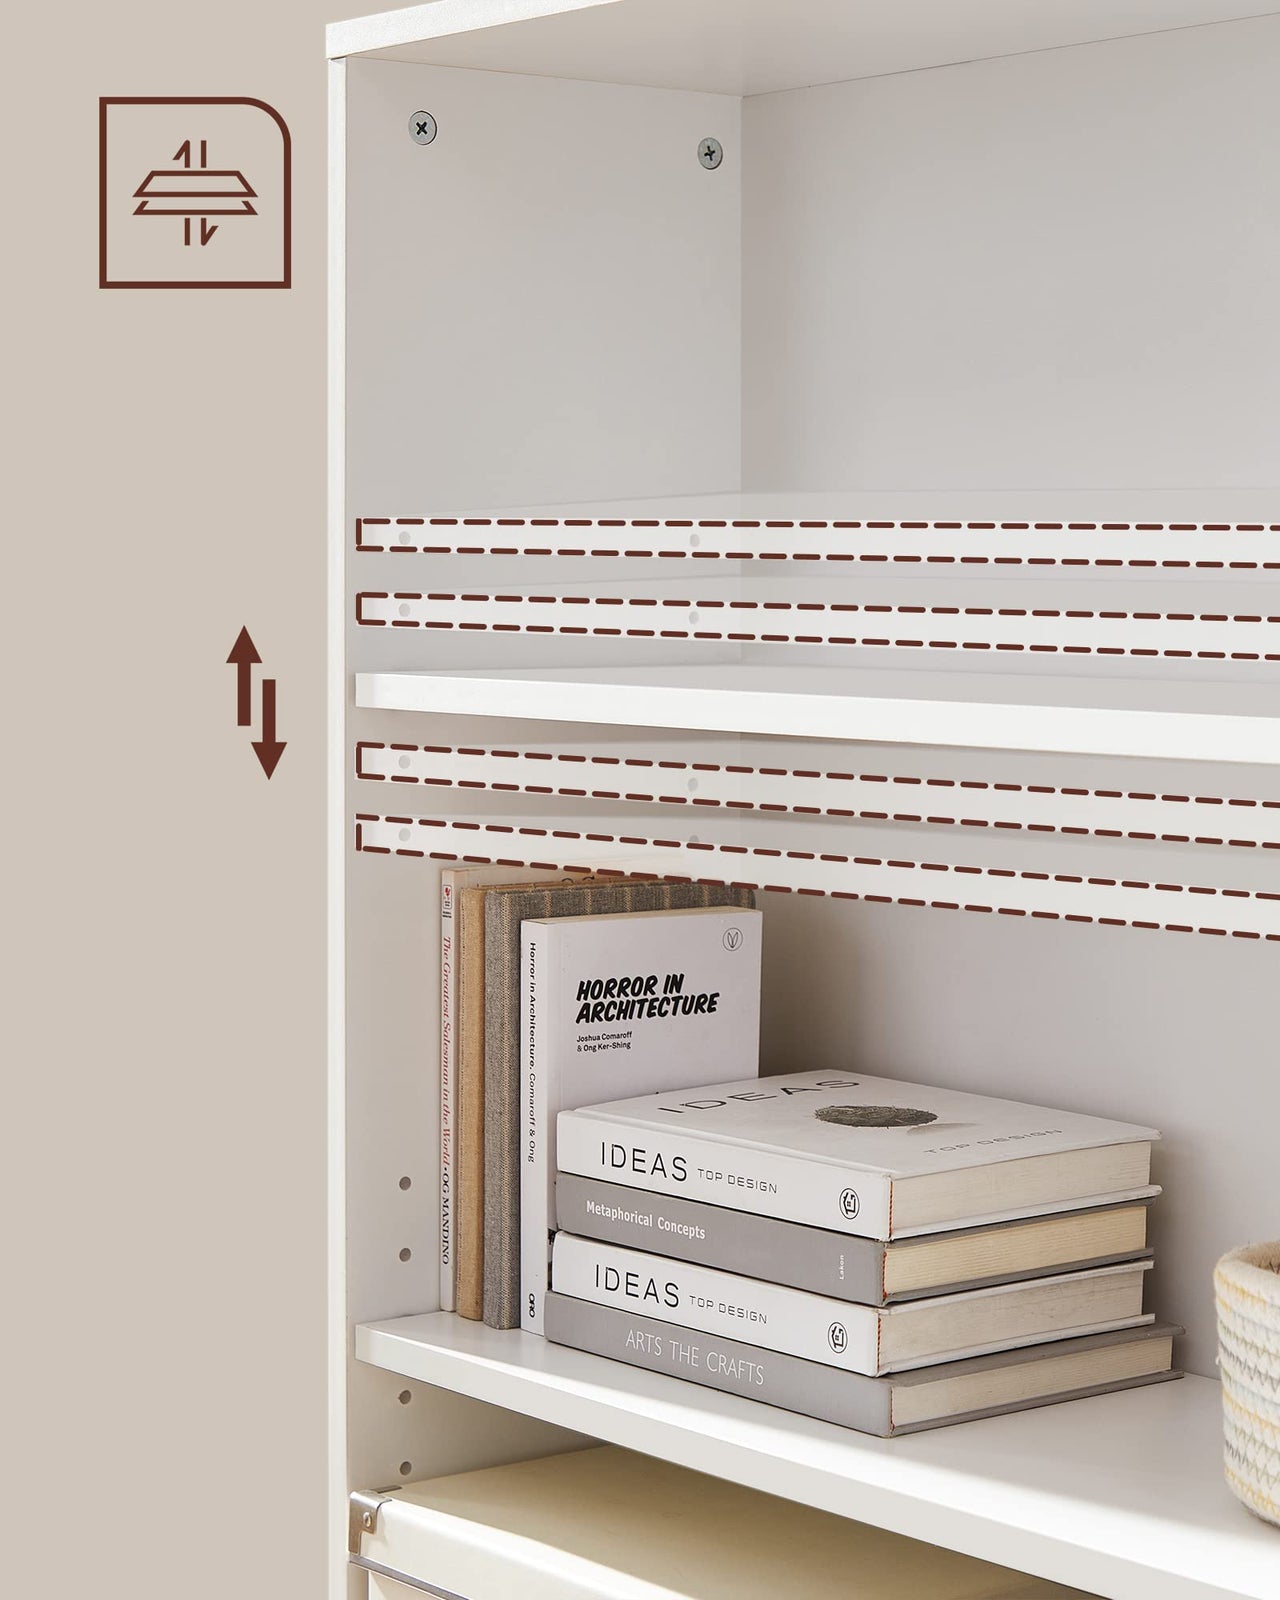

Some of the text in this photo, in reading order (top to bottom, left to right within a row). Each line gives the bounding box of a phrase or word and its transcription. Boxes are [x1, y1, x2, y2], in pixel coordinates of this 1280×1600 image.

[576, 973, 685, 1001] HORROR IN
[575, 992, 720, 1024] ARCHITECTURE
[527, 942, 537, 1163] Horror in Architecture. Comaroff & Ong
[576, 1030, 632, 1043] Joshua Comaroff
[577, 1040, 631, 1053] & Ong Ker-Shing
[442, 936, 452, 1265] The Greatest Salesman in the World OG MANDINO
[658, 1080, 860, 1114] IDEAS
[923, 1129, 1063, 1154] TOP DESIGN
[601, 1141, 778, 1194] IDEAS TOP DESIGN
[586, 1200, 706, 1240] Metaphorical Concepts
[595, 1264, 768, 1324] IDEAS TOP DESIGN
[625, 1328, 765, 1385] ARTS THE CRAFTS
